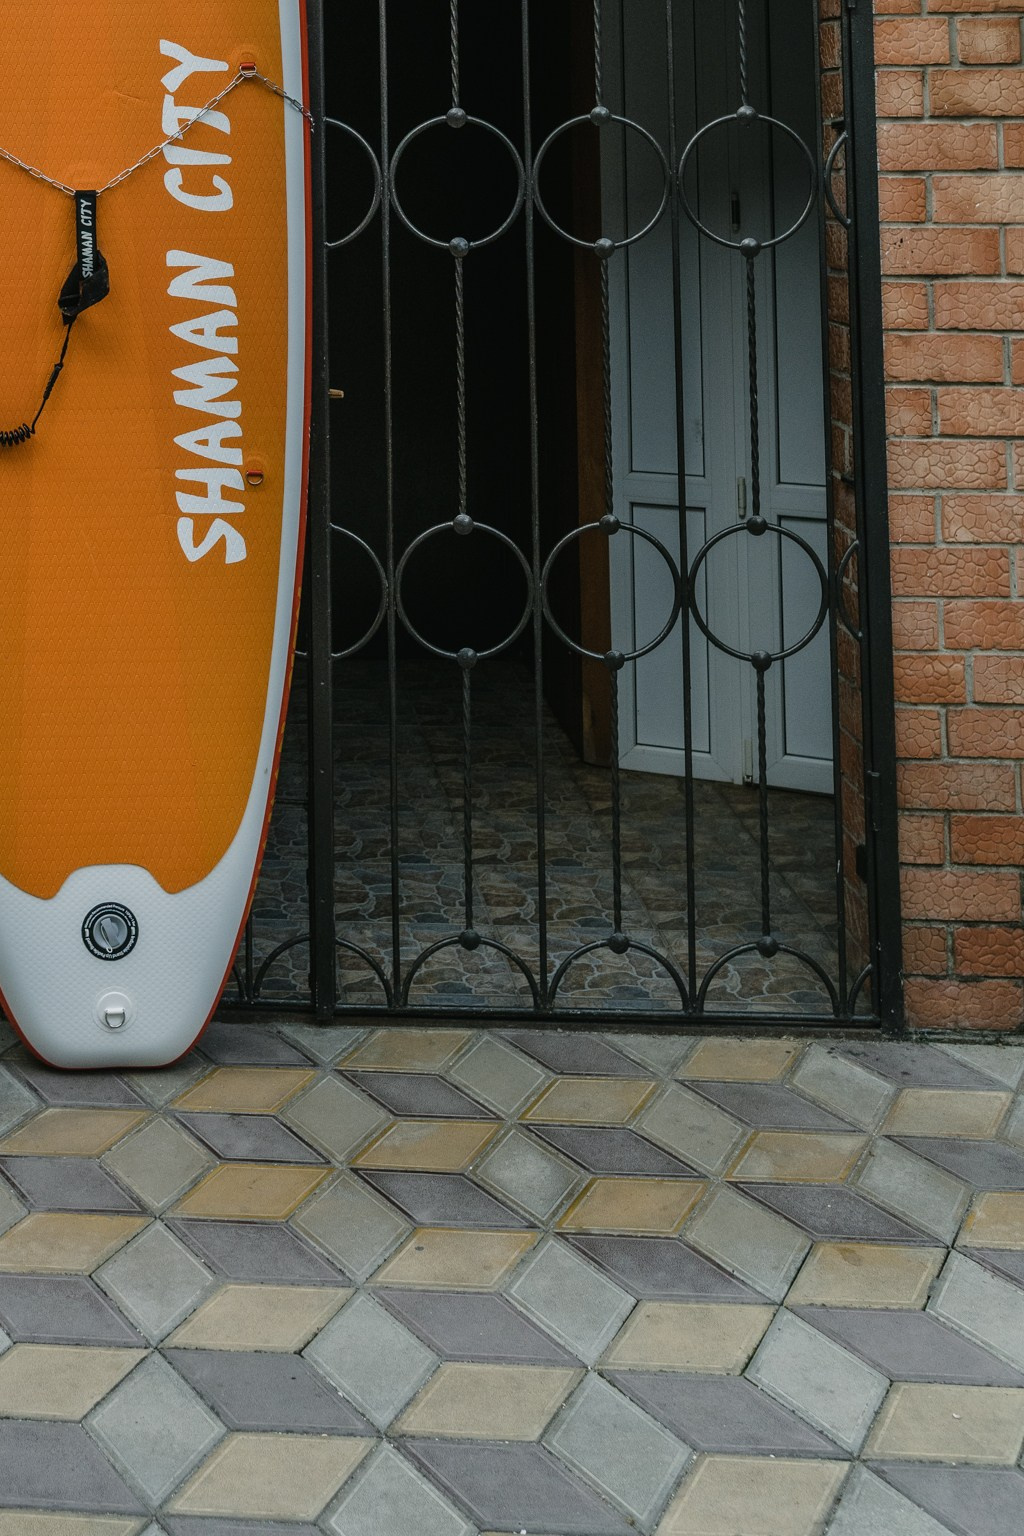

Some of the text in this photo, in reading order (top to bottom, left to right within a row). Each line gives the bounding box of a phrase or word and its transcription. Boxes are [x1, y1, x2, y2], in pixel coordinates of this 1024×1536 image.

[80, 199, 94, 279] SHAMAN CITY
[159, 38, 248, 565] SHAMAN CITY
